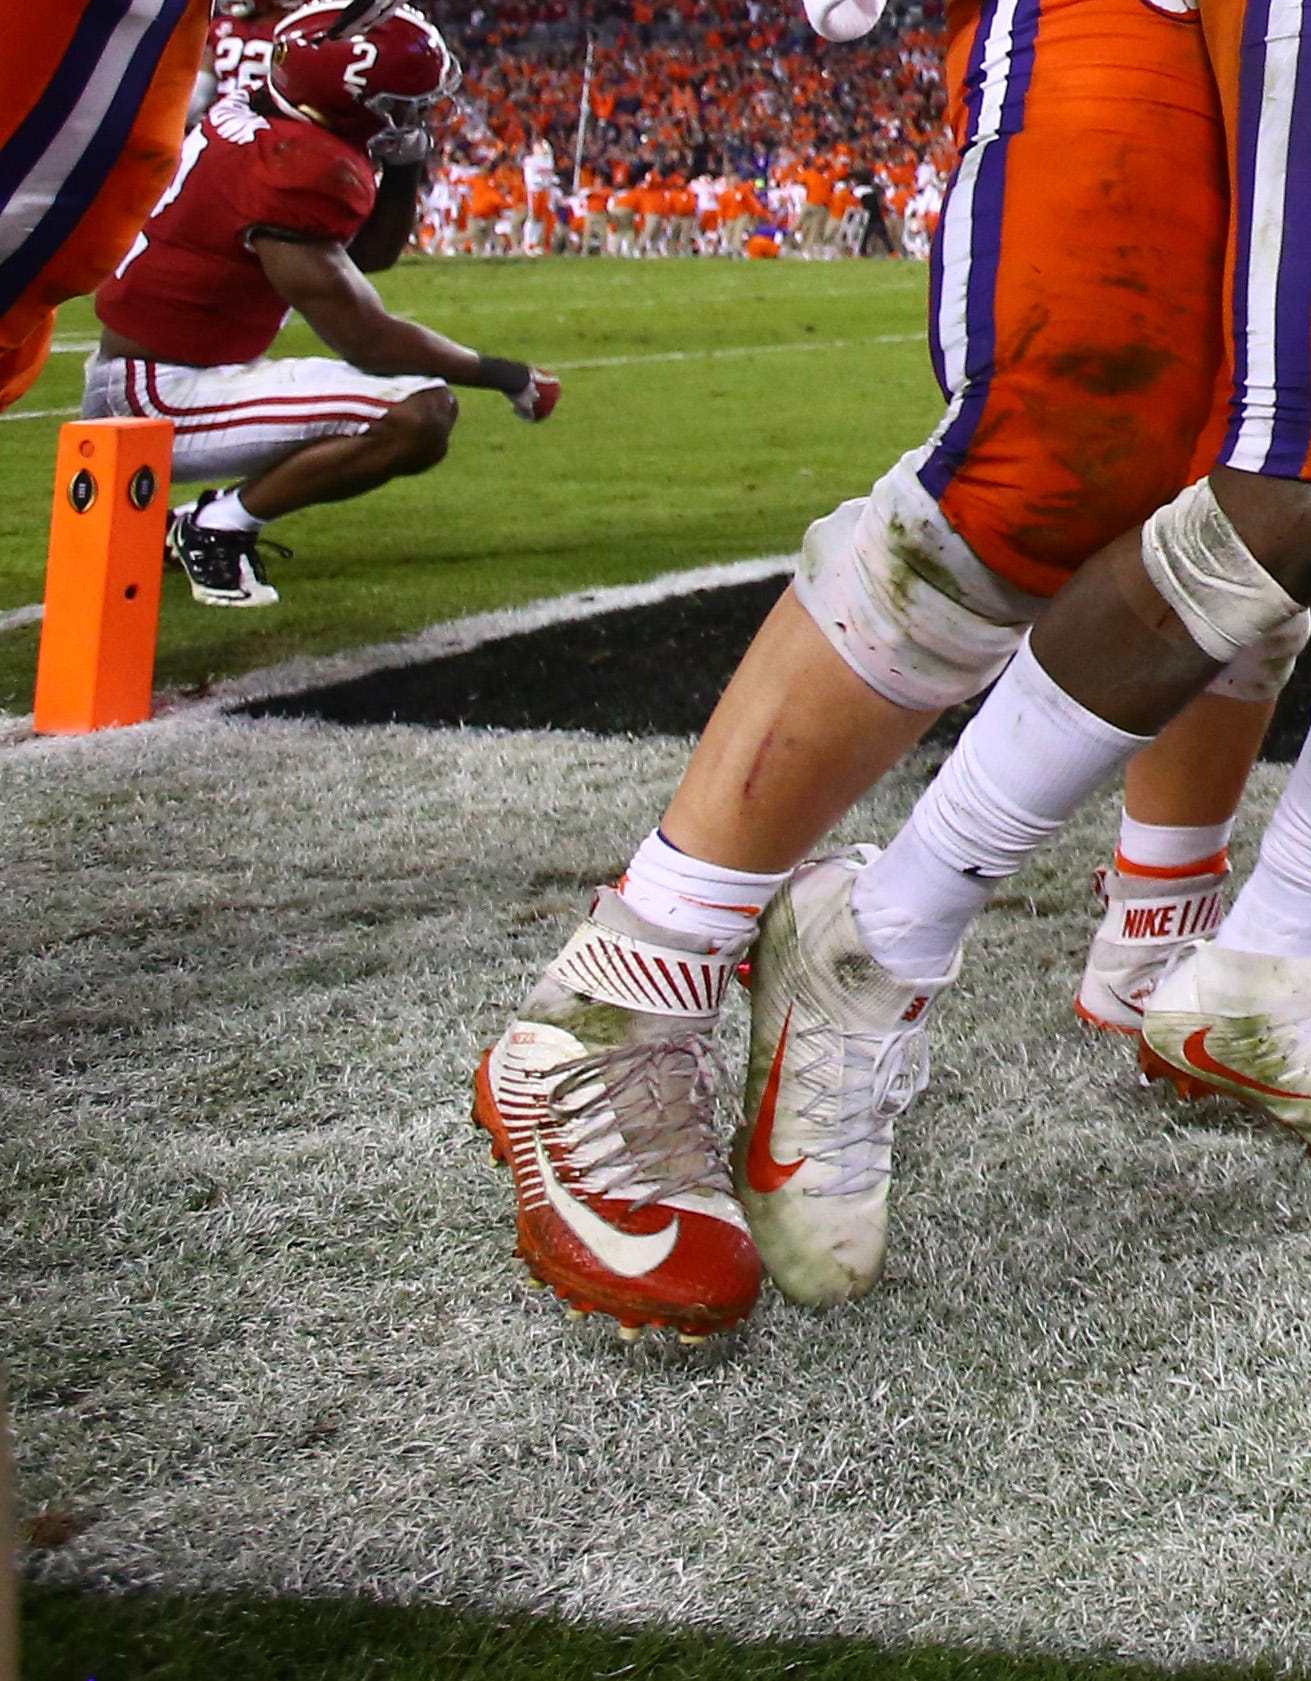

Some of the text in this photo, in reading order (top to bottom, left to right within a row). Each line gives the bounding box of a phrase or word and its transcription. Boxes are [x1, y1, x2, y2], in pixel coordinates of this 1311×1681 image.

[214, 37, 275, 93] 22
[343, 41, 377, 86] 2
[1122, 905, 1177, 938] NIKE
